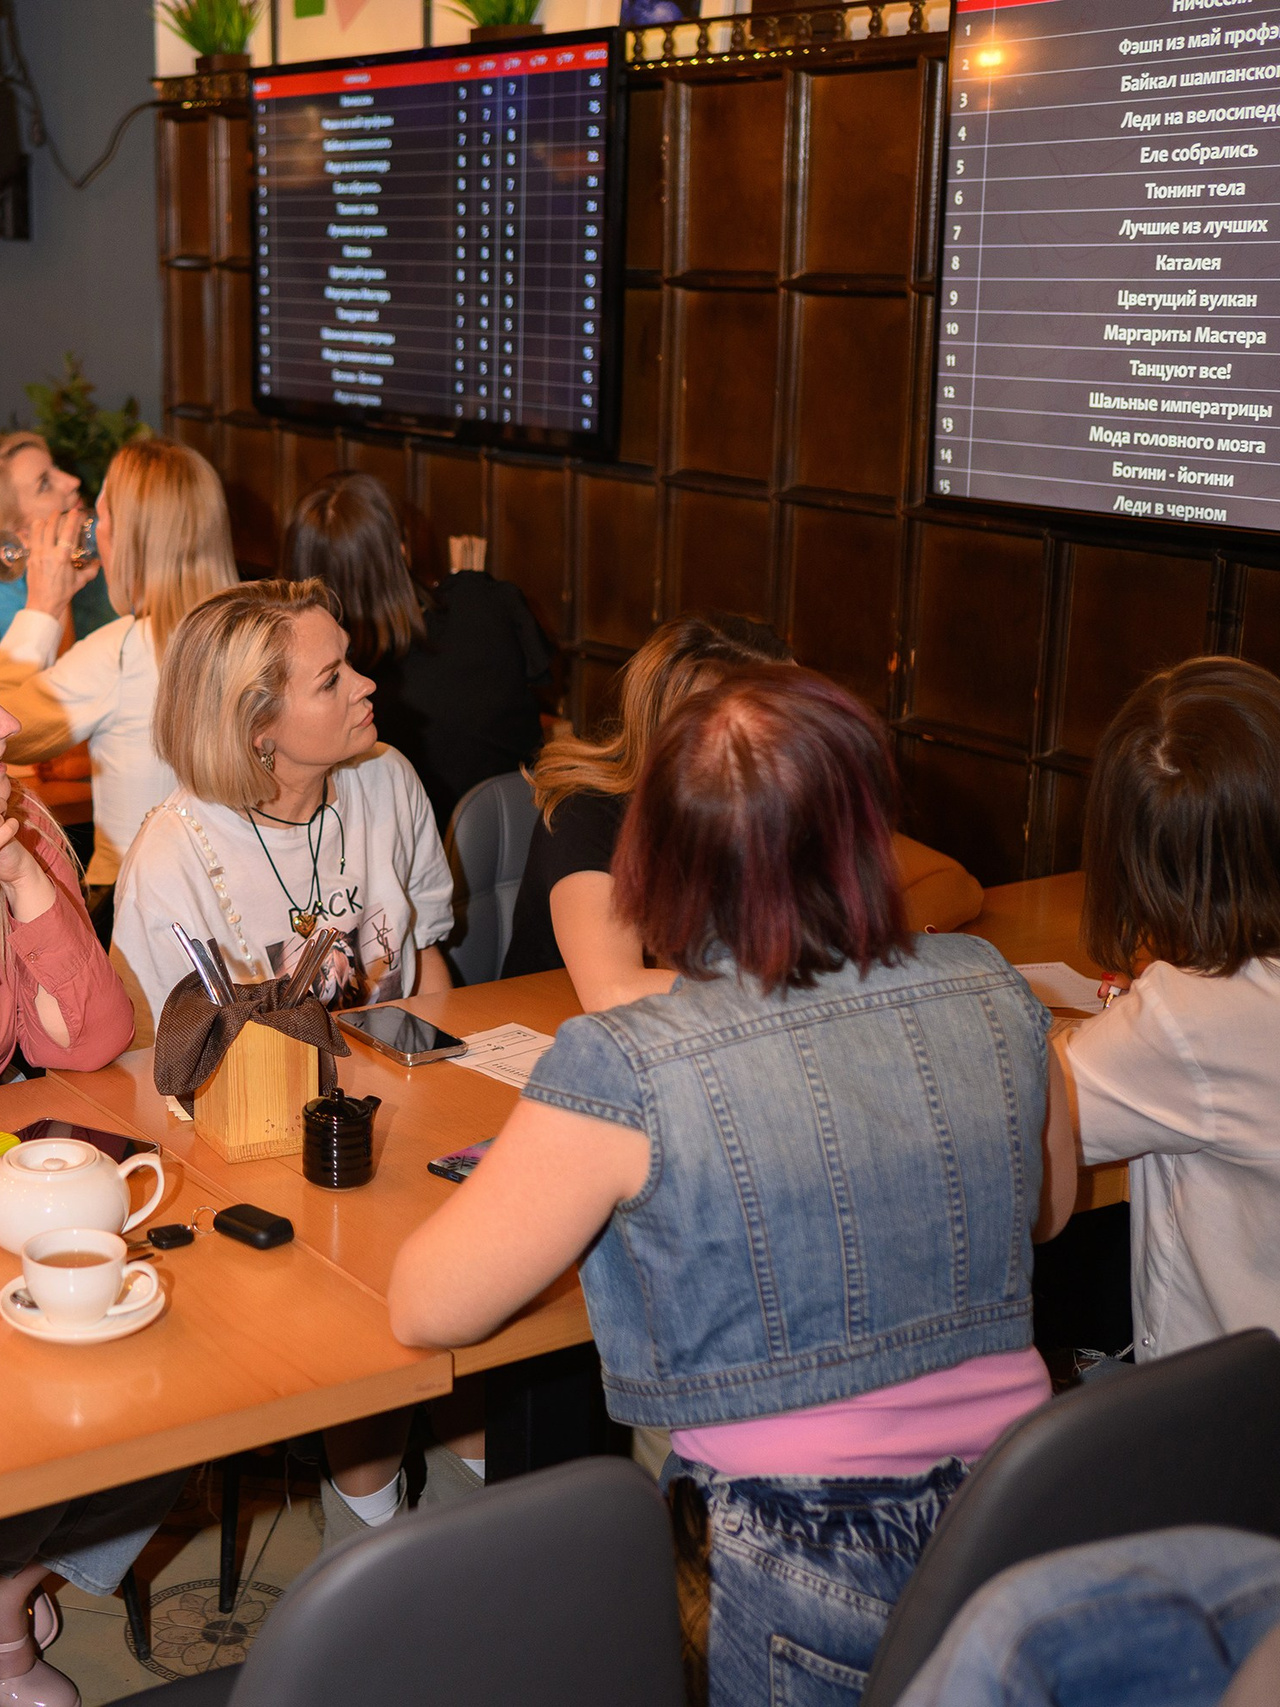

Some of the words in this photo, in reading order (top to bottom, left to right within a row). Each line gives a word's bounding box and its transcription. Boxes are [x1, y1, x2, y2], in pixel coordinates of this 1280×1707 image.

[965, 24, 971, 37] 1
[1119, 39, 1163, 55] Фэшн
[1166, 37, 1185, 50] из
[1188, 28, 1221, 48] май
[1224, 22, 1280, 45] профэ
[959, 92, 968, 109] 3
[1121, 73, 1177, 92] Байкал
[957, 125, 967, 142] 4
[1121, 112, 1161, 131] Леди
[1164, 112, 1183, 125] на
[956, 159, 965, 175] 5
[1140, 147, 1168, 163] Еле
[1172, 143, 1258, 164] собрались
[954, 190, 964, 205] 6
[1145, 183, 1205, 198] Тюнинг
[1208, 183, 1245, 196] тела
[953, 225, 962, 241] 7
[1119, 220, 1179, 239] Лучшие
[1183, 222, 1201, 234] из
[1203, 220, 1268, 238] лучших
[951, 255, 960, 271] 8
[1156, 255, 1221, 270] Каталея
[949, 290, 958, 306] 9
[1118, 290, 1196, 310] Цветущий
[1200, 294, 1257, 309] вулкан
[946, 322, 959, 335] 10
[1104, 325, 1191, 346] Маргариты
[1194, 327, 1266, 348] Мастера
[946, 354, 956, 367] 11
[1130, 360, 1197, 381] Танцуют
[1199, 364, 1232, 379] все!
[943, 385, 955, 399] 12
[1089, 392, 1158, 411] Шальные
[1160, 400, 1272, 422] императрицы
[942, 417, 954, 433] 13
[1089, 426, 1130, 446] Мода
[1134, 433, 1214, 450] головного
[1217, 439, 1265, 453] мозга
[940, 448, 952, 464] 14
[1113, 462, 1166, 481] Богини
[1178, 466, 1234, 487] йогини
[939, 479, 951, 495] 15
[1113, 496, 1151, 516] Леди
[1155, 503, 1163, 514] в
[1167, 504, 1226, 521] черном
